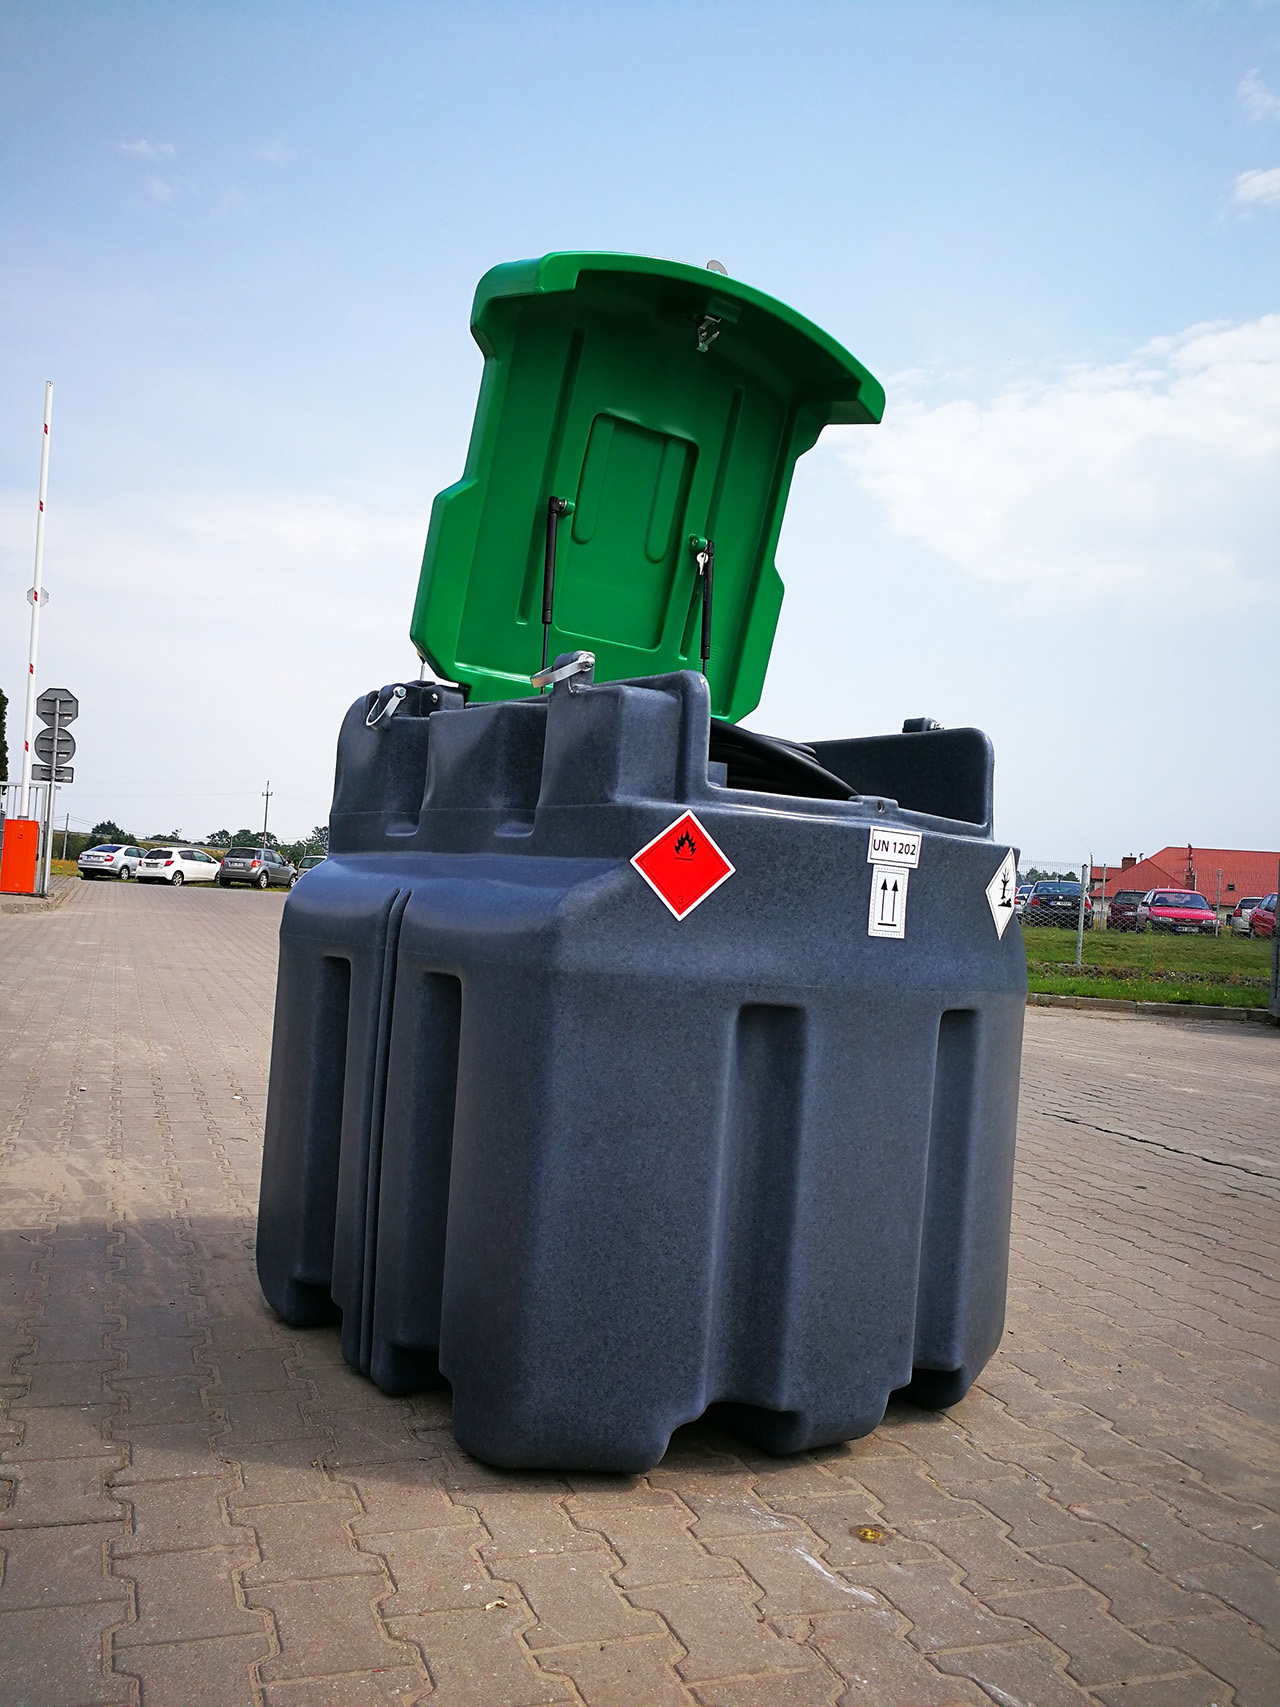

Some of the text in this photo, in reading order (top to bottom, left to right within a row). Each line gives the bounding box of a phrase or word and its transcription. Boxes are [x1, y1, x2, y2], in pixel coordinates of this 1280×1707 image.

[873, 839, 916, 856] UN 1202
[677, 895, 684, 904] 3
